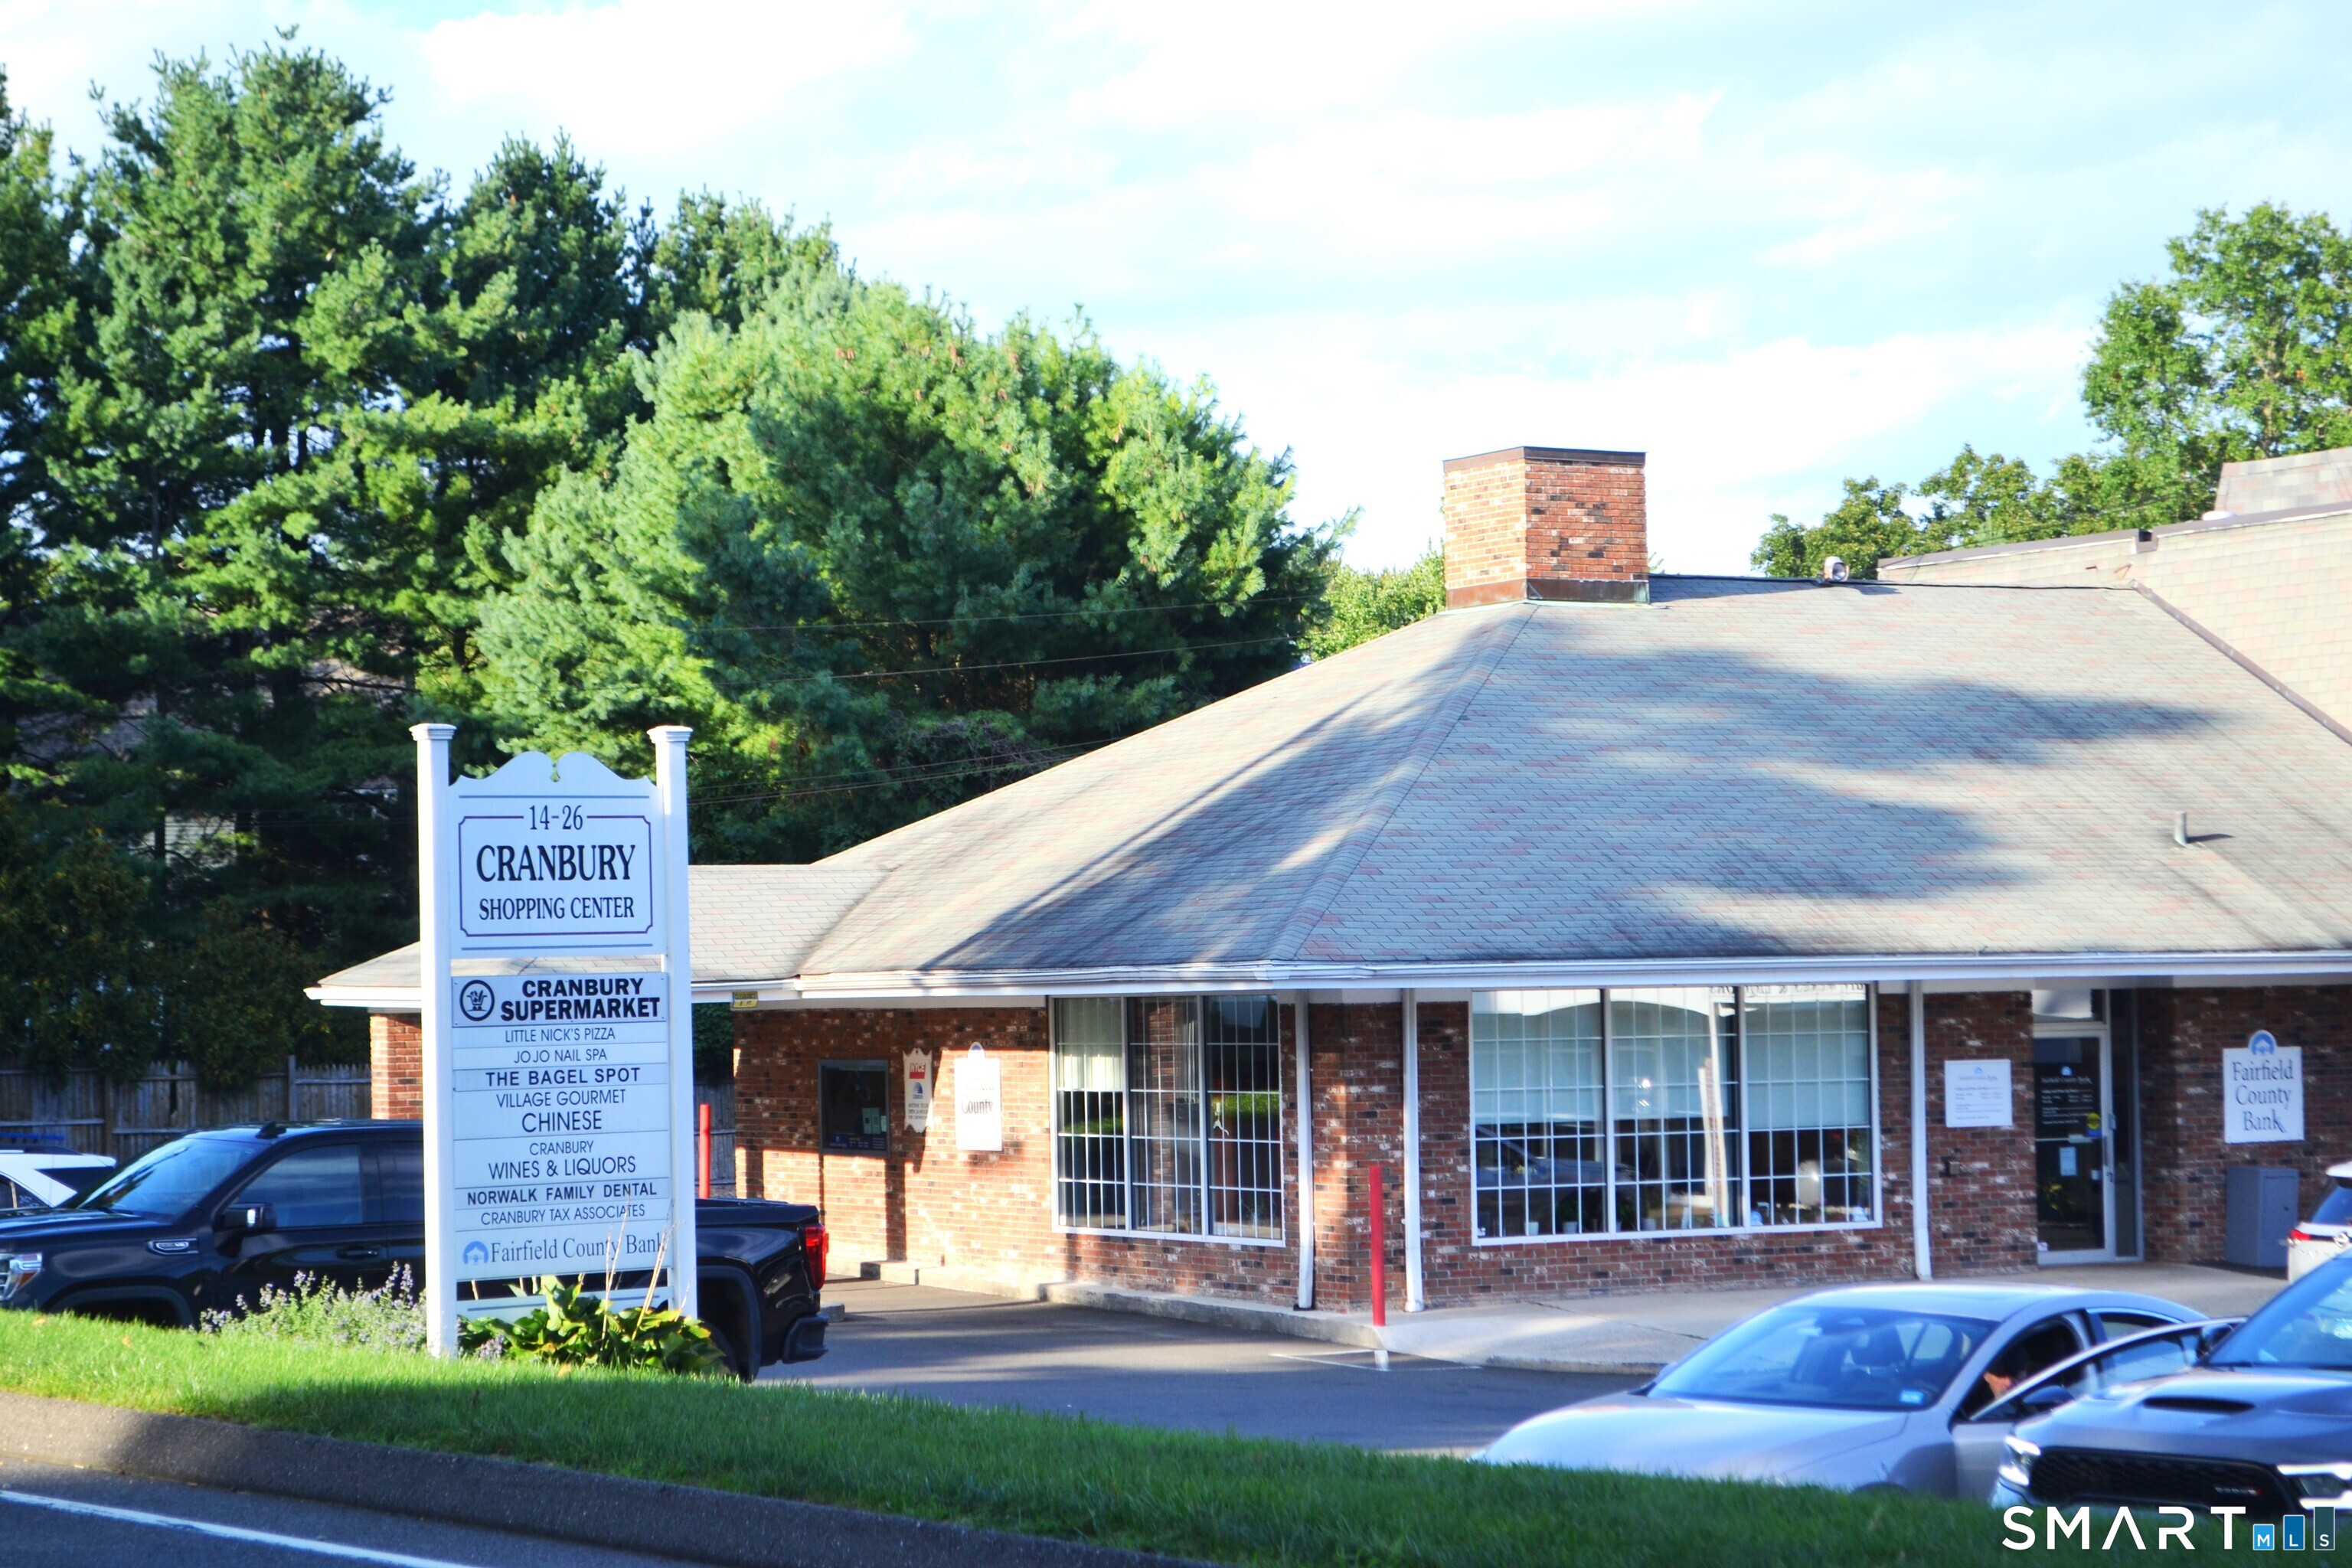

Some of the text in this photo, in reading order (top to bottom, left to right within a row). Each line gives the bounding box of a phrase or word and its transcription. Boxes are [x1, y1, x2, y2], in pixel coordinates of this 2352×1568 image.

[529, 805, 583, 831] 14-26
[476, 844, 636, 883] CRANBURY
[479, 897, 635, 920] SHOPPING CENTER
[521, 978, 645, 998] CRANBURY
[500, 997, 661, 1022] SUPERMARKET
[505, 1027, 616, 1044] LITTLE NICK'S PIZZA
[554, 1049, 581, 1062] NAIL
[585, 1048, 607, 1061] SPA
[485, 1067, 641, 1087] THE BAGEL SPOT
[2232, 1059, 2295, 1081] Fairfield
[495, 1088, 626, 1108] VILLAGE GOURMET
[2235, 1084, 2292, 1110] County
[521, 1110, 602, 1133] CHINESE
[2243, 1109, 2287, 1133] Bank
[529, 1140, 594, 1156] CRANBURY
[488, 1155, 636, 1180] WINES & LIQUORS
[467, 1182, 658, 1206] NORWALK FAMILY DENTAL
[481, 1204, 645, 1226] CRANBURY TAX ASSOCIATES
[491, 1234, 558, 1263] Fairfield
